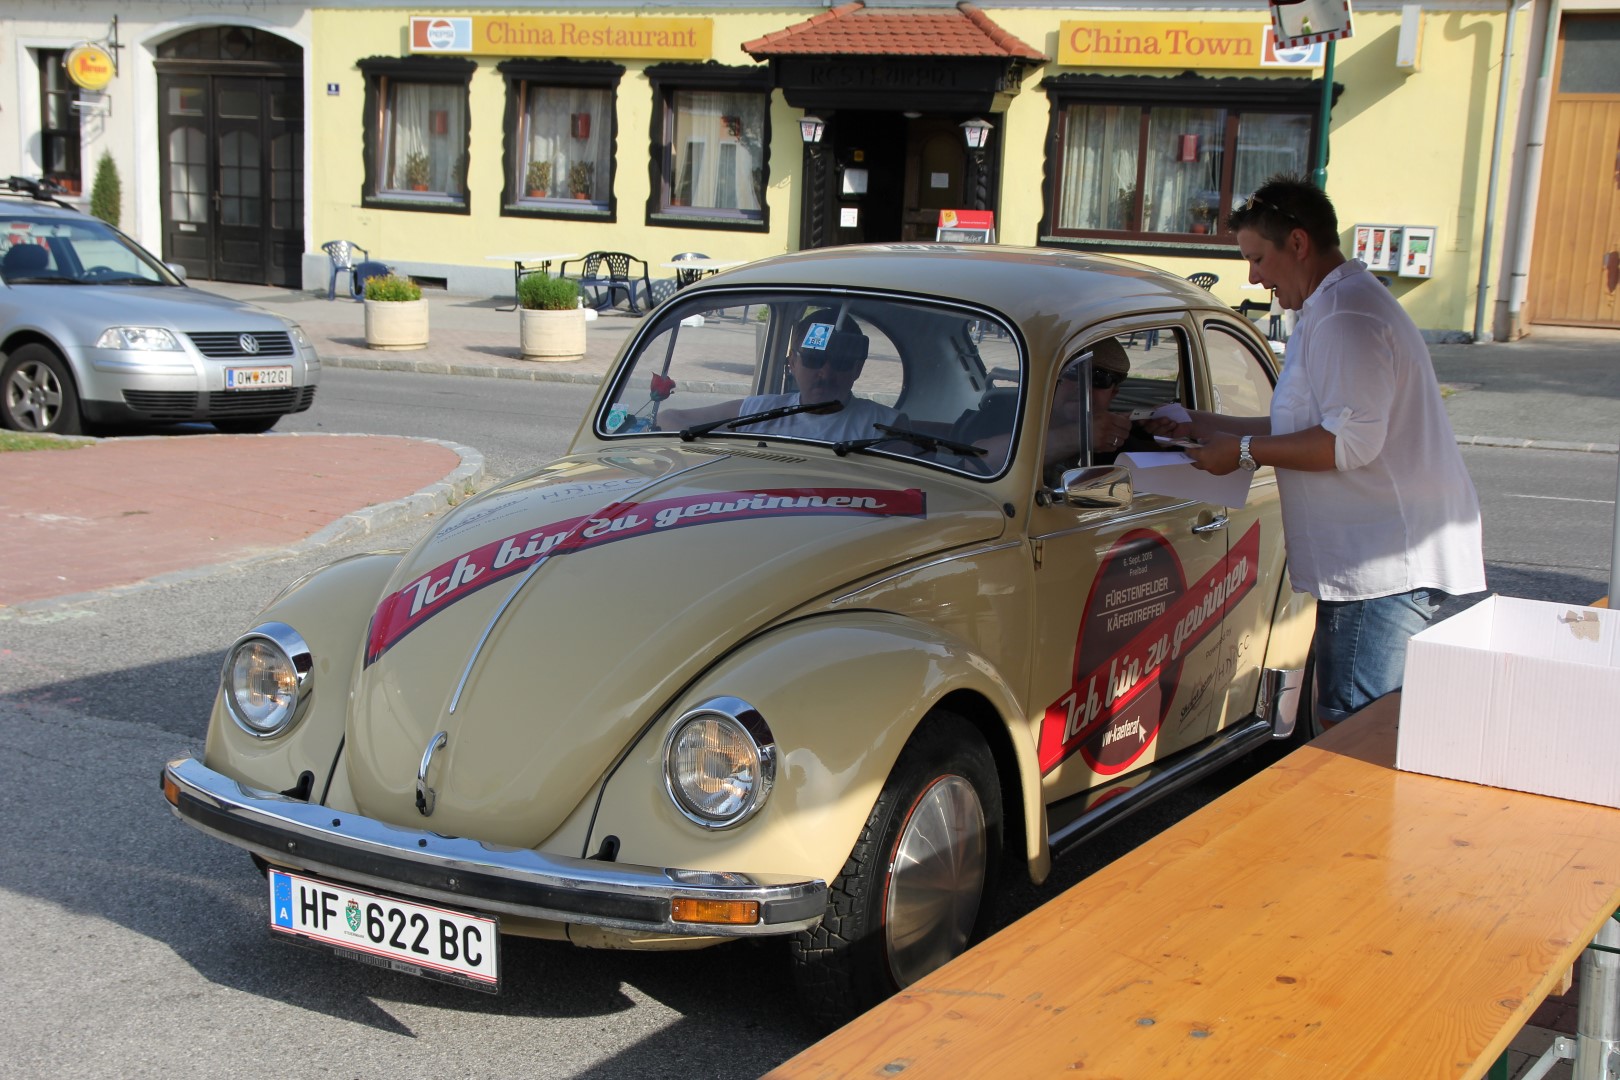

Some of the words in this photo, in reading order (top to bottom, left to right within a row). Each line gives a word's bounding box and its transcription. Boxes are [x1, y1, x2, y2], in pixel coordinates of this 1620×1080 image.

[485, 20, 555, 46] China
[560, 22, 697, 48] Restaurant
[1070, 26, 1161, 55] China
[1165, 29, 1253, 56] Town
[237, 371, 251, 385] OW
[403, 554, 486, 617] Ich
[493, 530, 576, 569] bin
[582, 513, 648, 540] zu
[654, 493, 887, 528] gewinnen
[1129, 564, 1148, 577] Freibad
[1105, 576, 1169, 608] FÜRSTENFELDER
[1107, 600, 1166, 632] KÄFERTREFFEN
[1060, 675, 1102, 745] Ich
[1105, 654, 1143, 708] bin
[1144, 633, 1171, 675] zu
[1172, 555, 1249, 660] gewinnen
[279, 907, 289, 920] A
[300, 885, 339, 931] HF
[366, 903, 430, 956] 622
[439, 918, 483, 967] BC
